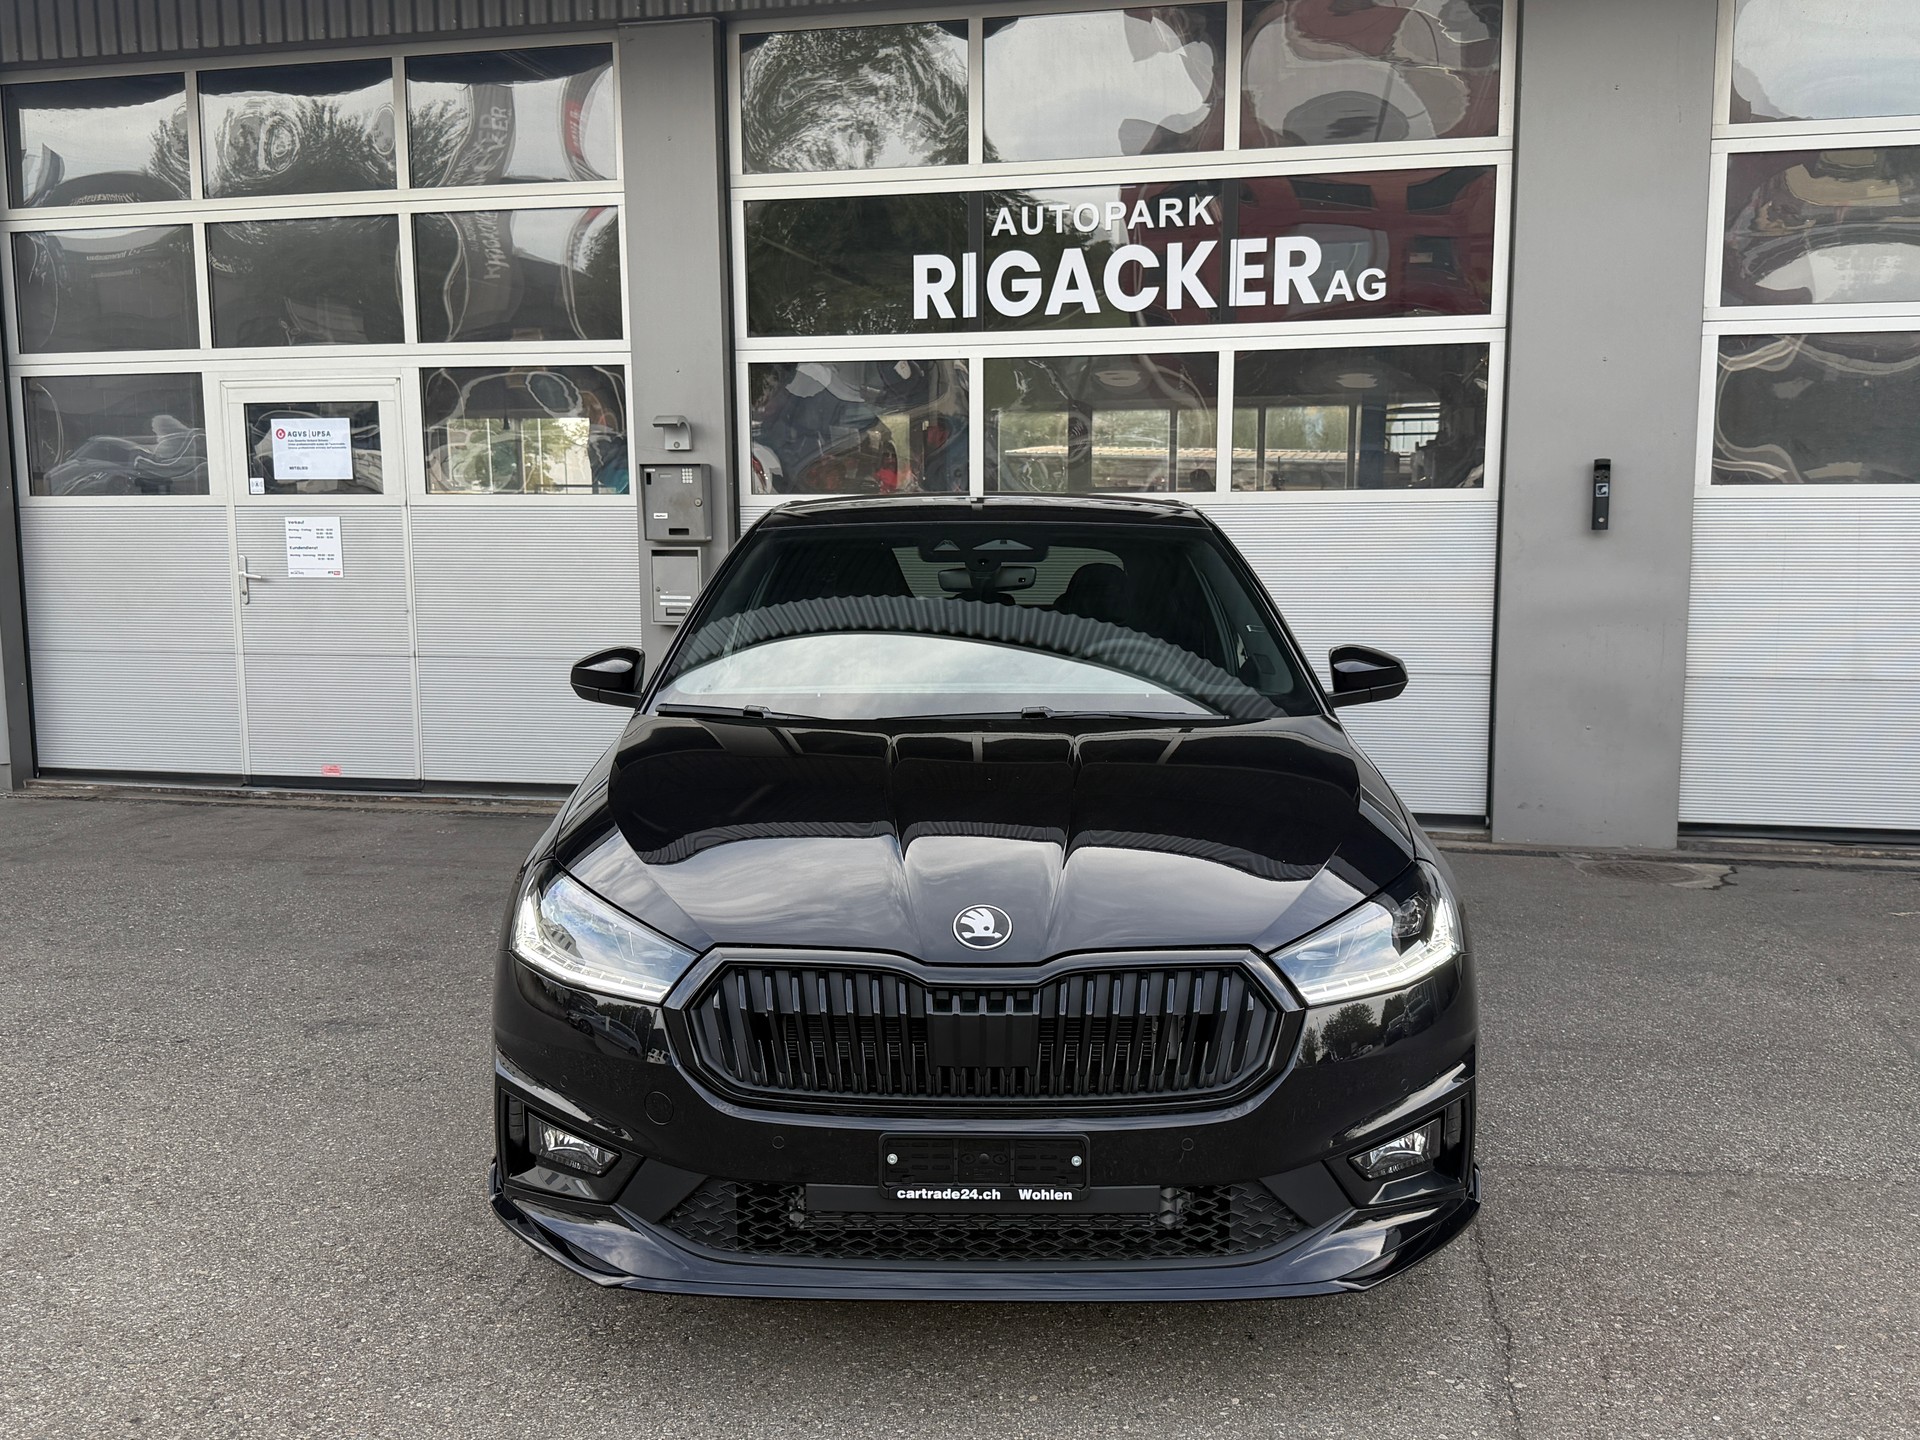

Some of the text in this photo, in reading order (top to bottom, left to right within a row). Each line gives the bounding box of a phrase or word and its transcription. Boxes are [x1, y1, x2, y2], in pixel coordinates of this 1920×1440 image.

[991, 195, 1216, 236] AUTOPARK
[912, 235, 1388, 321] RIGACKER AG
[896, 1188, 1073, 1201] cartrade24.ch Wohlen
